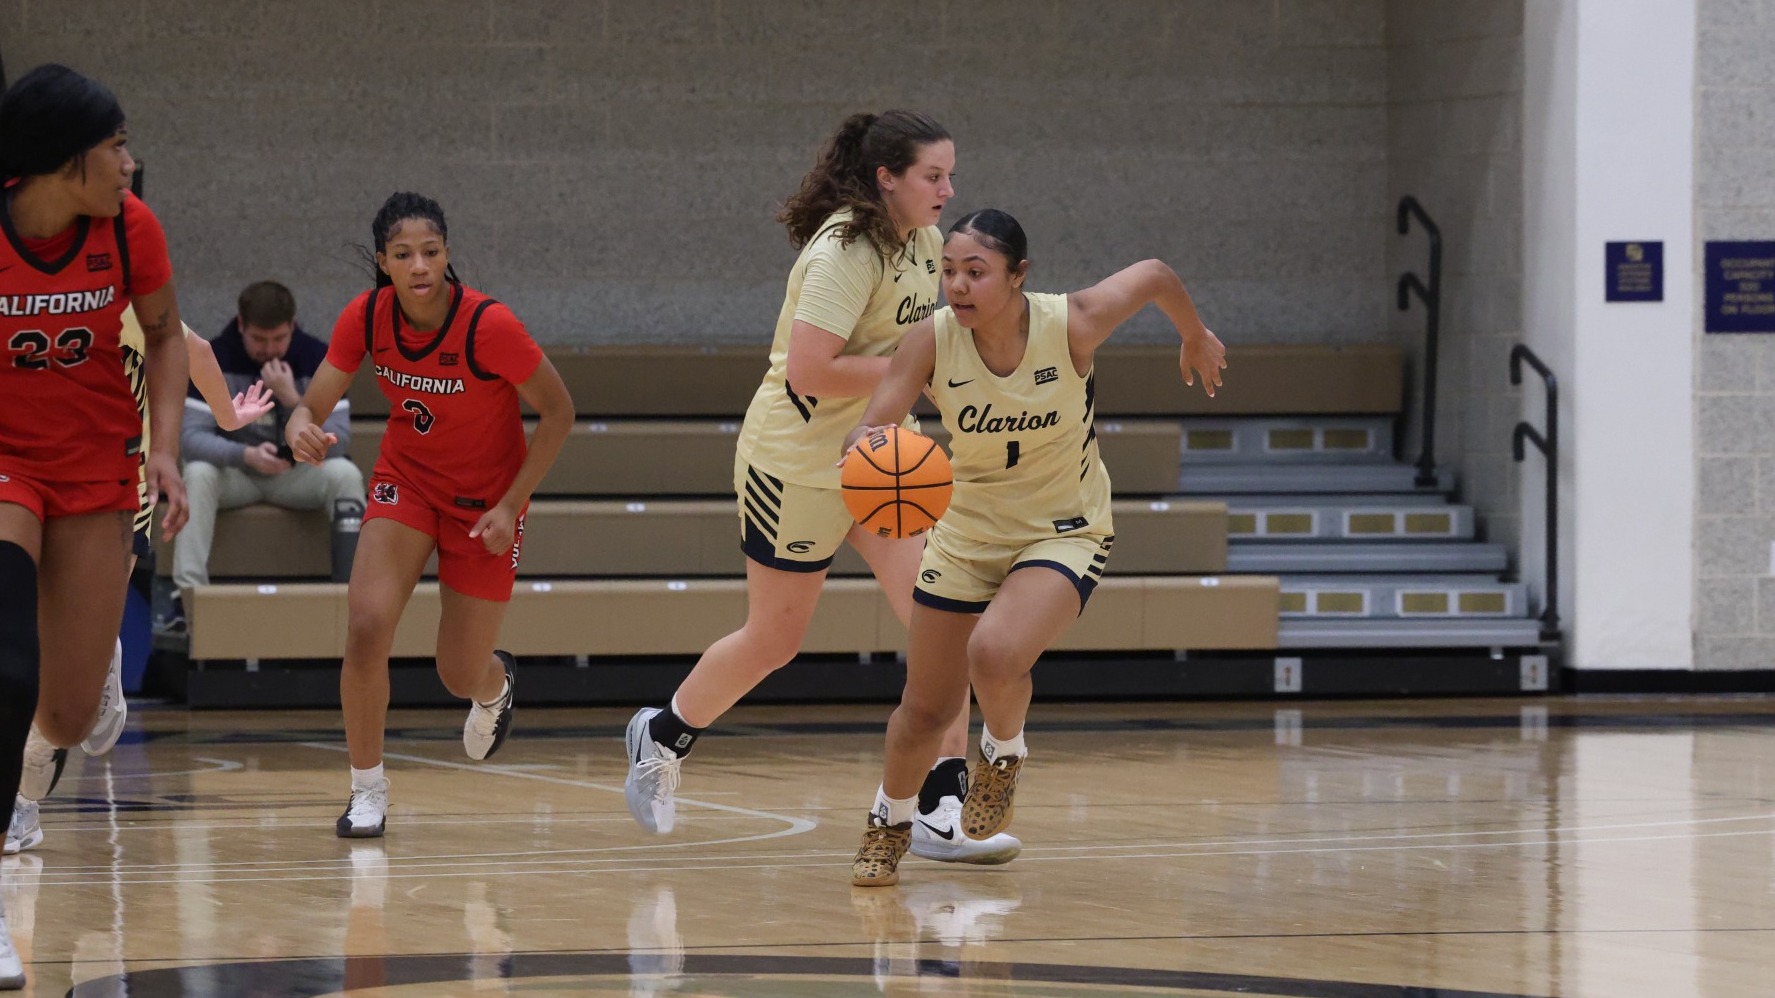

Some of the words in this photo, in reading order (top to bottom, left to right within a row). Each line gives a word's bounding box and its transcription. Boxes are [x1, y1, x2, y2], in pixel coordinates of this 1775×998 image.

[0, 285, 115, 316] ALIFORNIA
[8, 326, 94, 370] 23
[375, 364, 465, 394] CALIFORNIA
[1034, 369, 1059, 383] PSAC
[957, 403, 1061, 433] Clarion
[1005, 440, 1020, 470] 1
